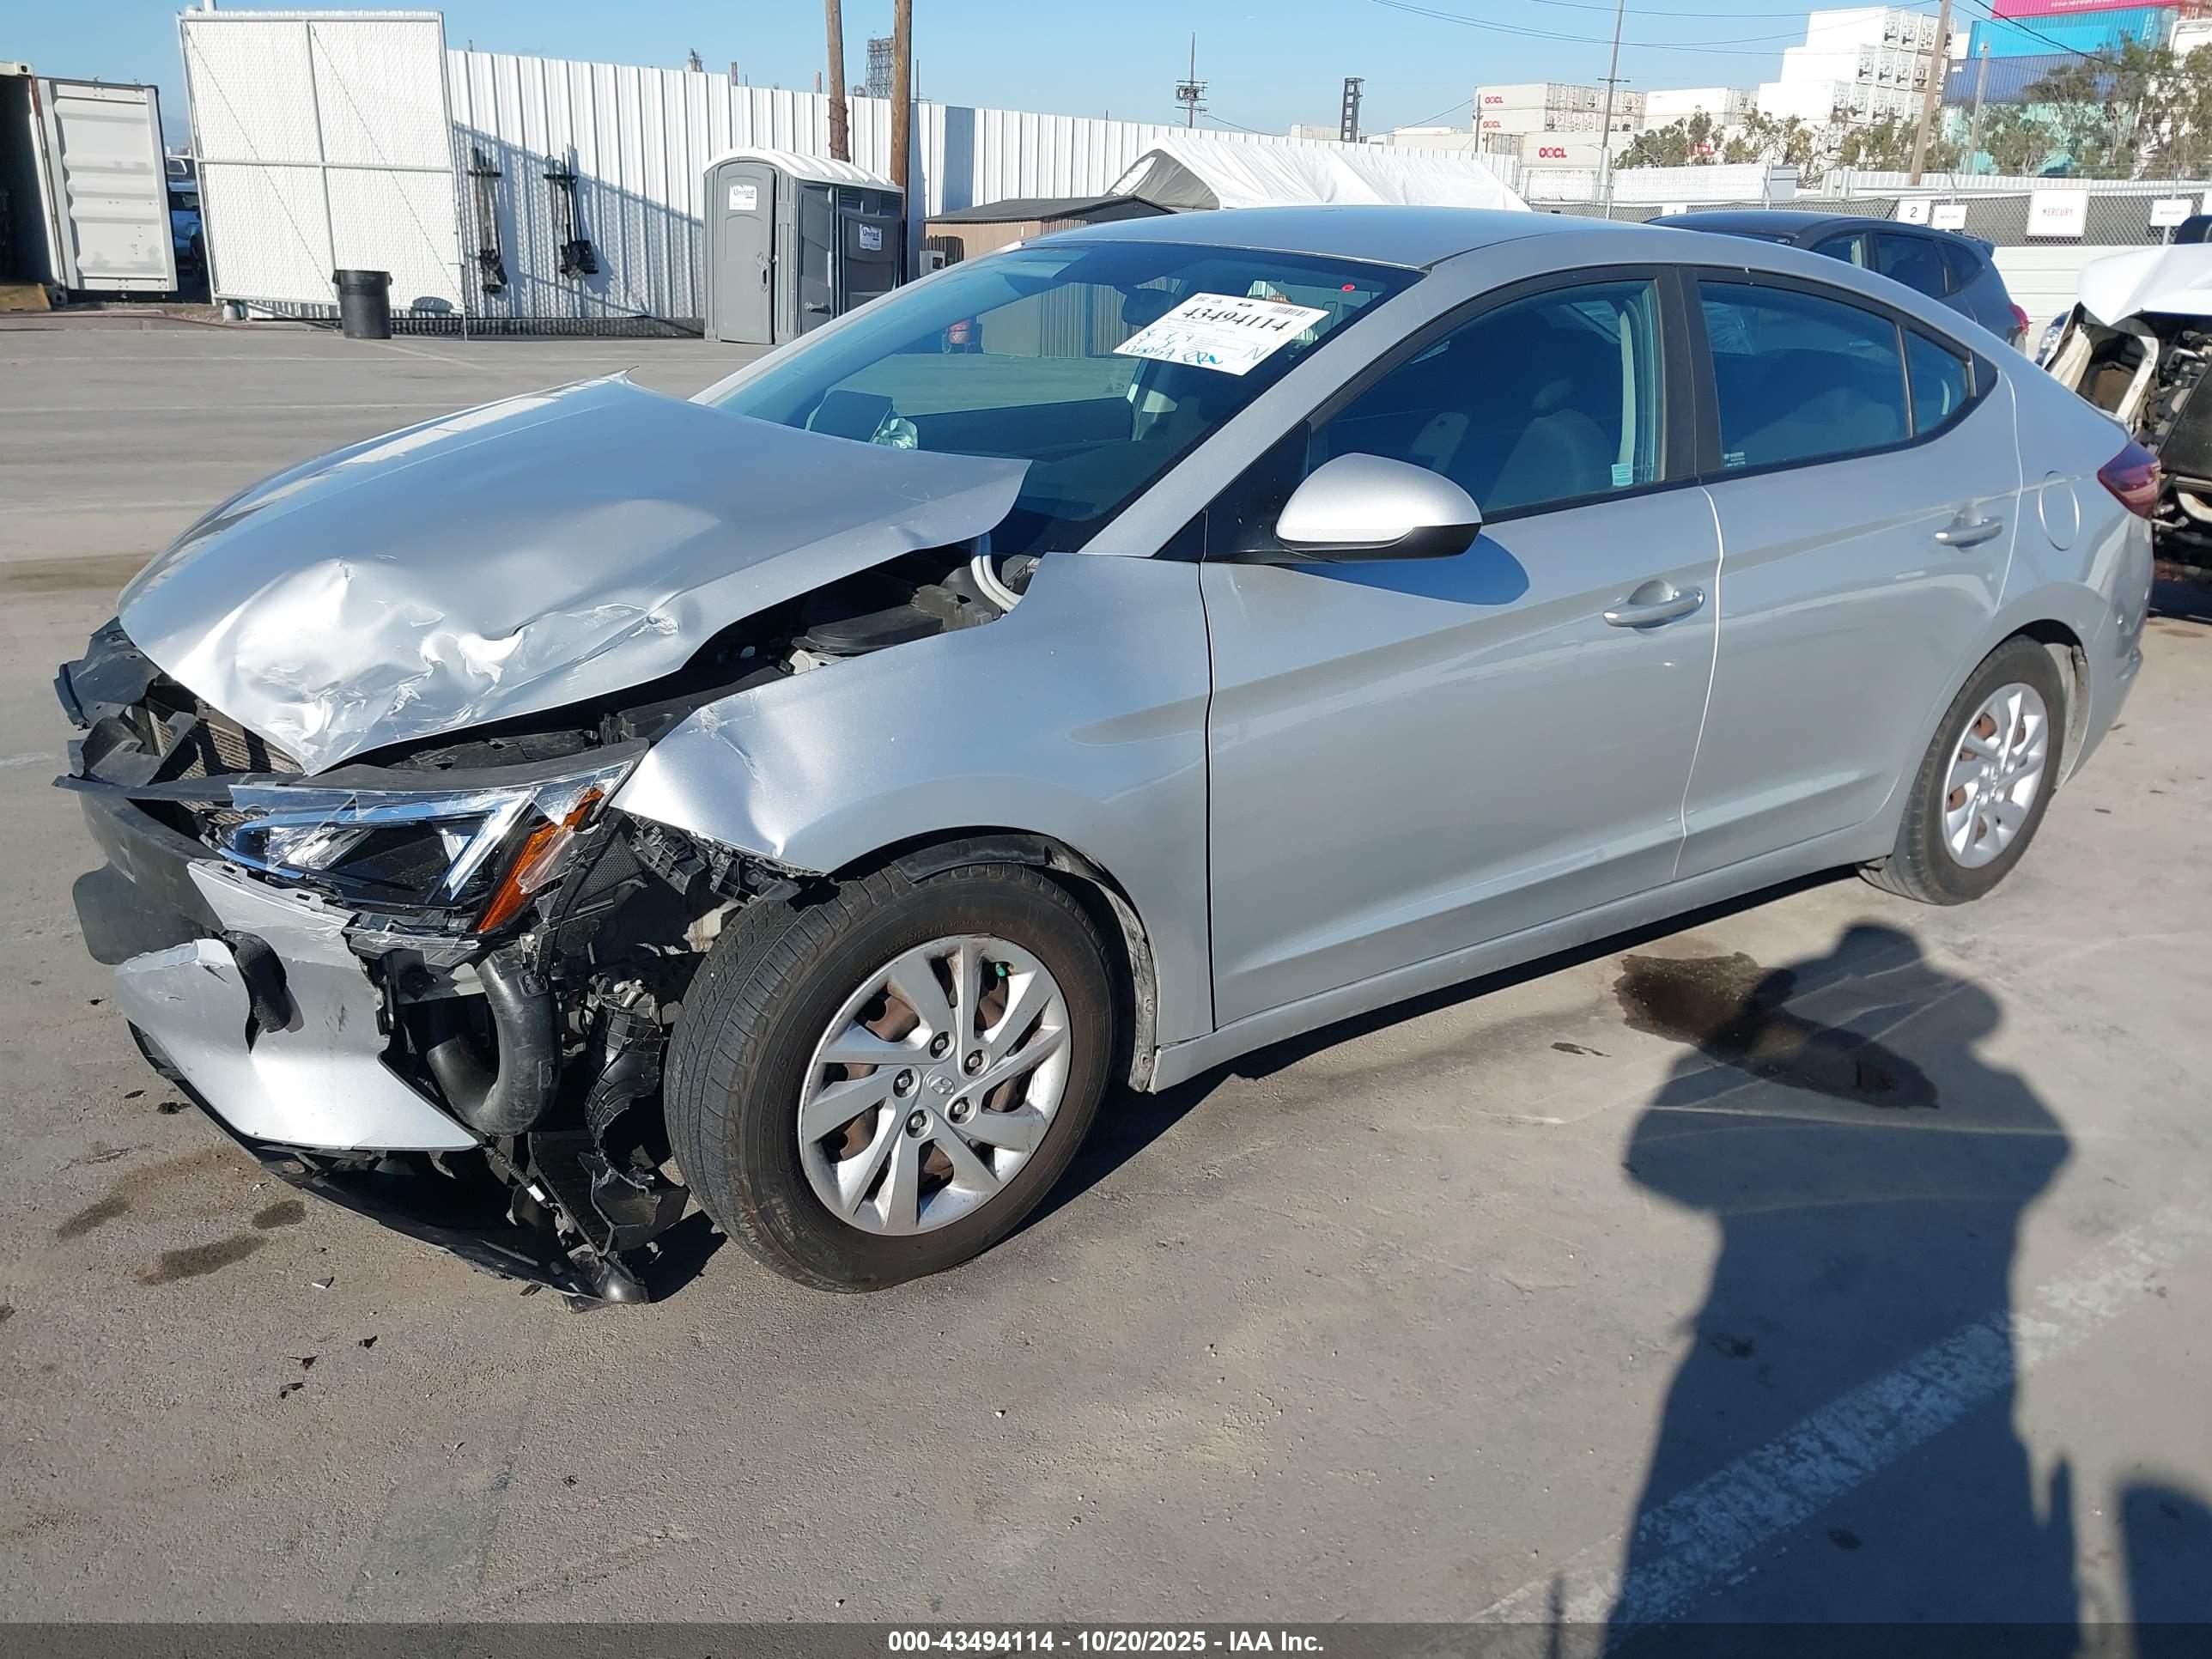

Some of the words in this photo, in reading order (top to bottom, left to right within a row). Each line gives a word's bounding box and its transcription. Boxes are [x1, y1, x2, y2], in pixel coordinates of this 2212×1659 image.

[1483, 120, 1502, 129] OOCL
[1539, 147, 1567, 159] OOCL
[733, 187, 755, 197] United
[1910, 206, 1917, 218] 2
[2042, 208, 2074, 217] MERCURY
[862, 228, 880, 239] United
[1182, 307, 1291, 331] 43494114
